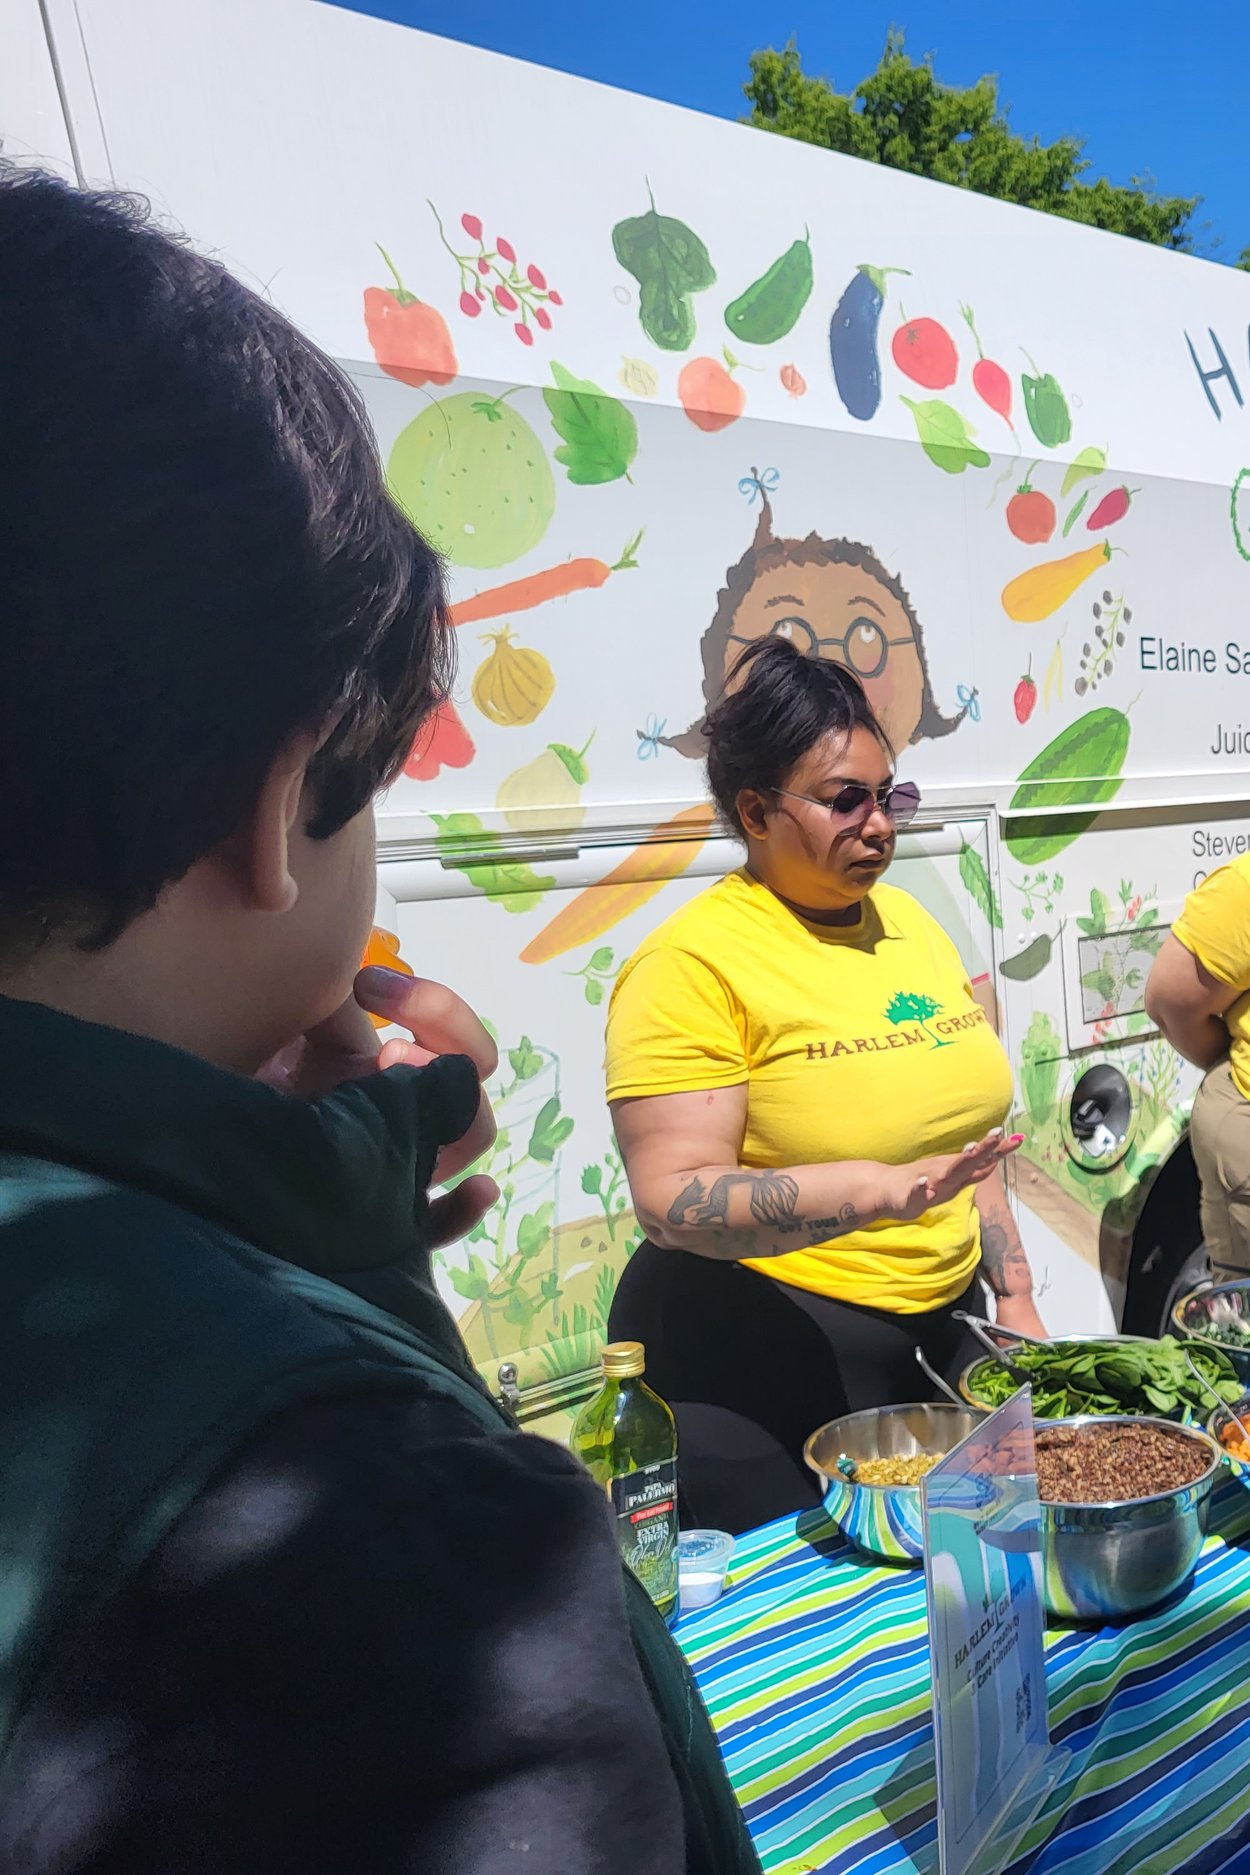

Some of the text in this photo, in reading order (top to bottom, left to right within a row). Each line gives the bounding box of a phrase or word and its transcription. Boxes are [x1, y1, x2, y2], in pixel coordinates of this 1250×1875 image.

[1140, 636, 1217, 673] Elaine
[805, 1009, 986, 1060] HARLEM GROW
[628, 1483, 675, 1508] PALERMO
[636, 1520, 669, 1537] EXTRA
[637, 1527, 669, 1545] VIRGIN
[954, 1611, 995, 1670] HARLEM
[967, 1649, 991, 1683] Culture
[977, 1665, 993, 1689] Care
